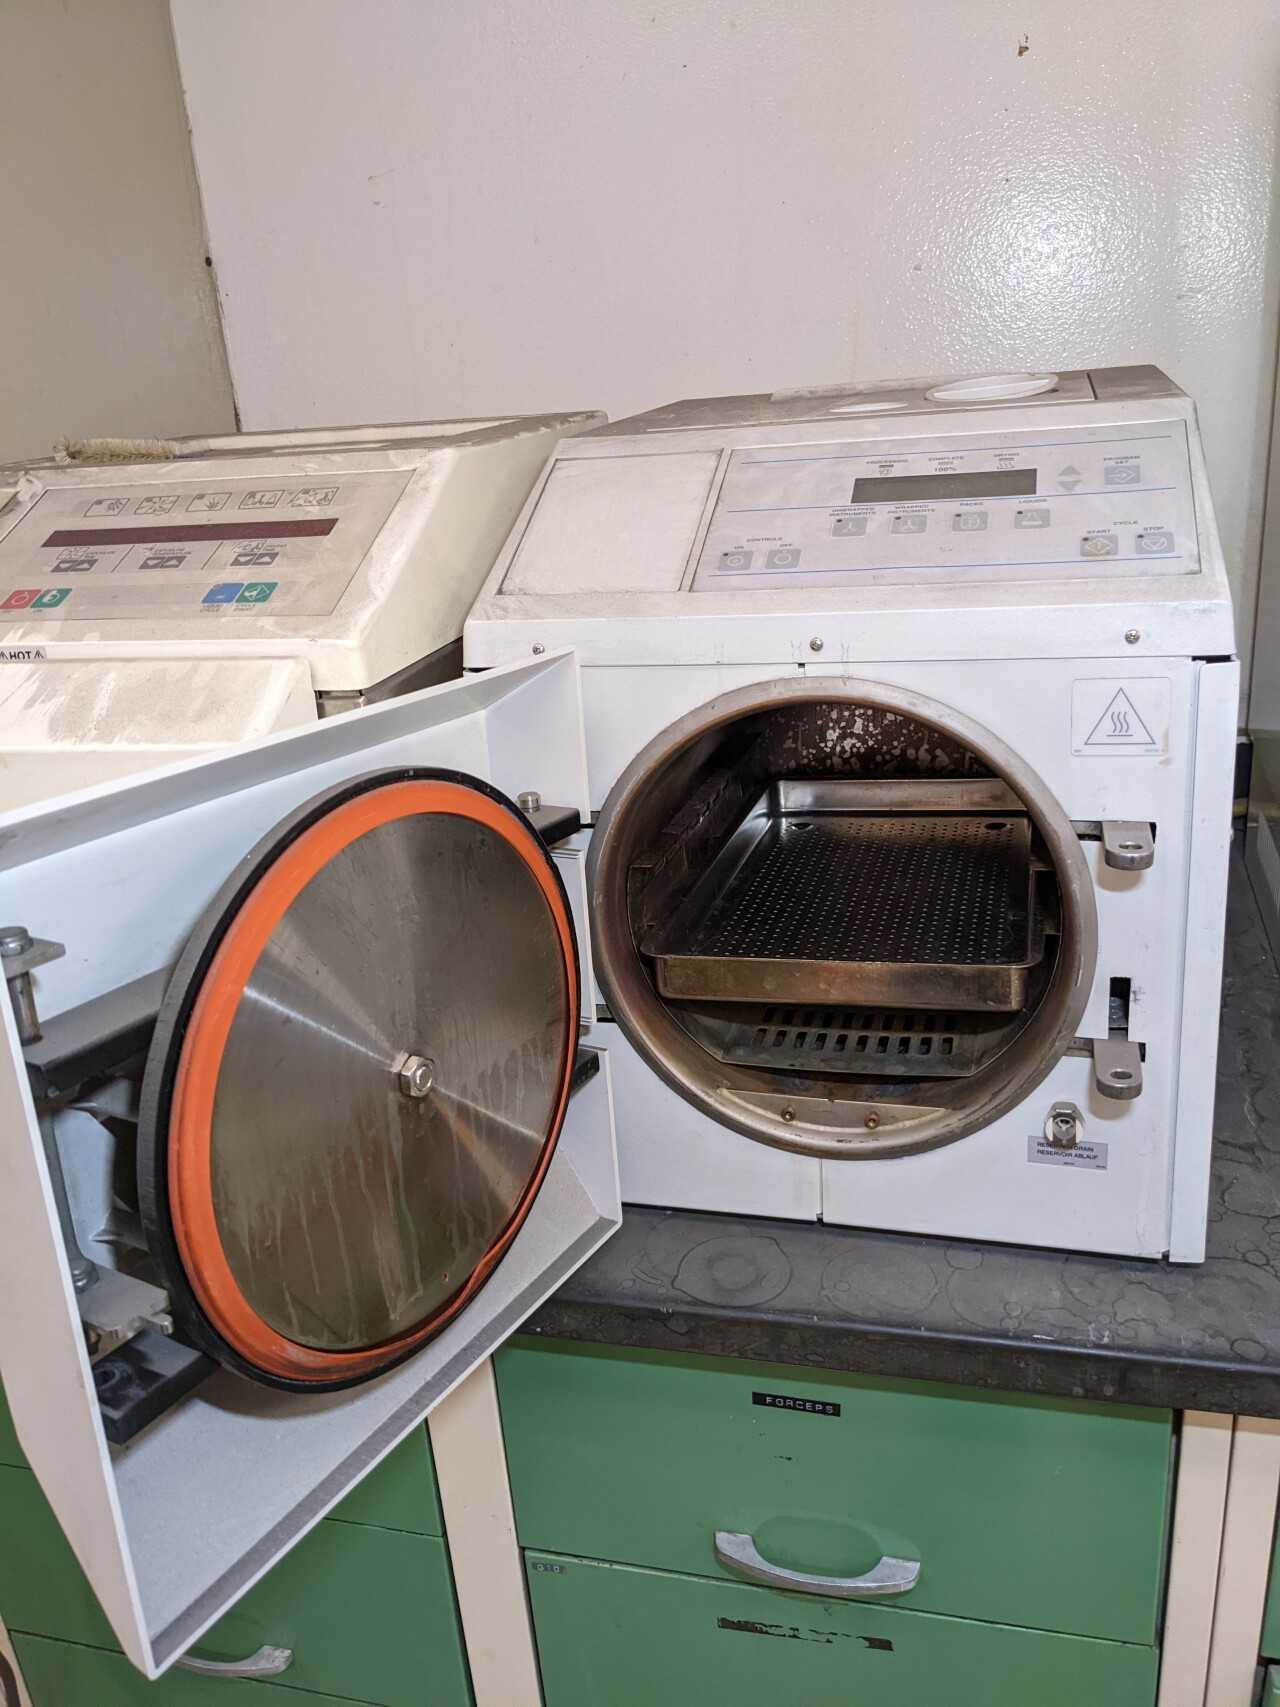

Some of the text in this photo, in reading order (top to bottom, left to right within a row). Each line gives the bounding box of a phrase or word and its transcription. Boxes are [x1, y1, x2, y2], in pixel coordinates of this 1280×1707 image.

[9, 650, 32, 660] HOT
[1037, 1149, 1073, 1157] RESERVOIR
[766, 1397, 833, 1413] FORCEPS
